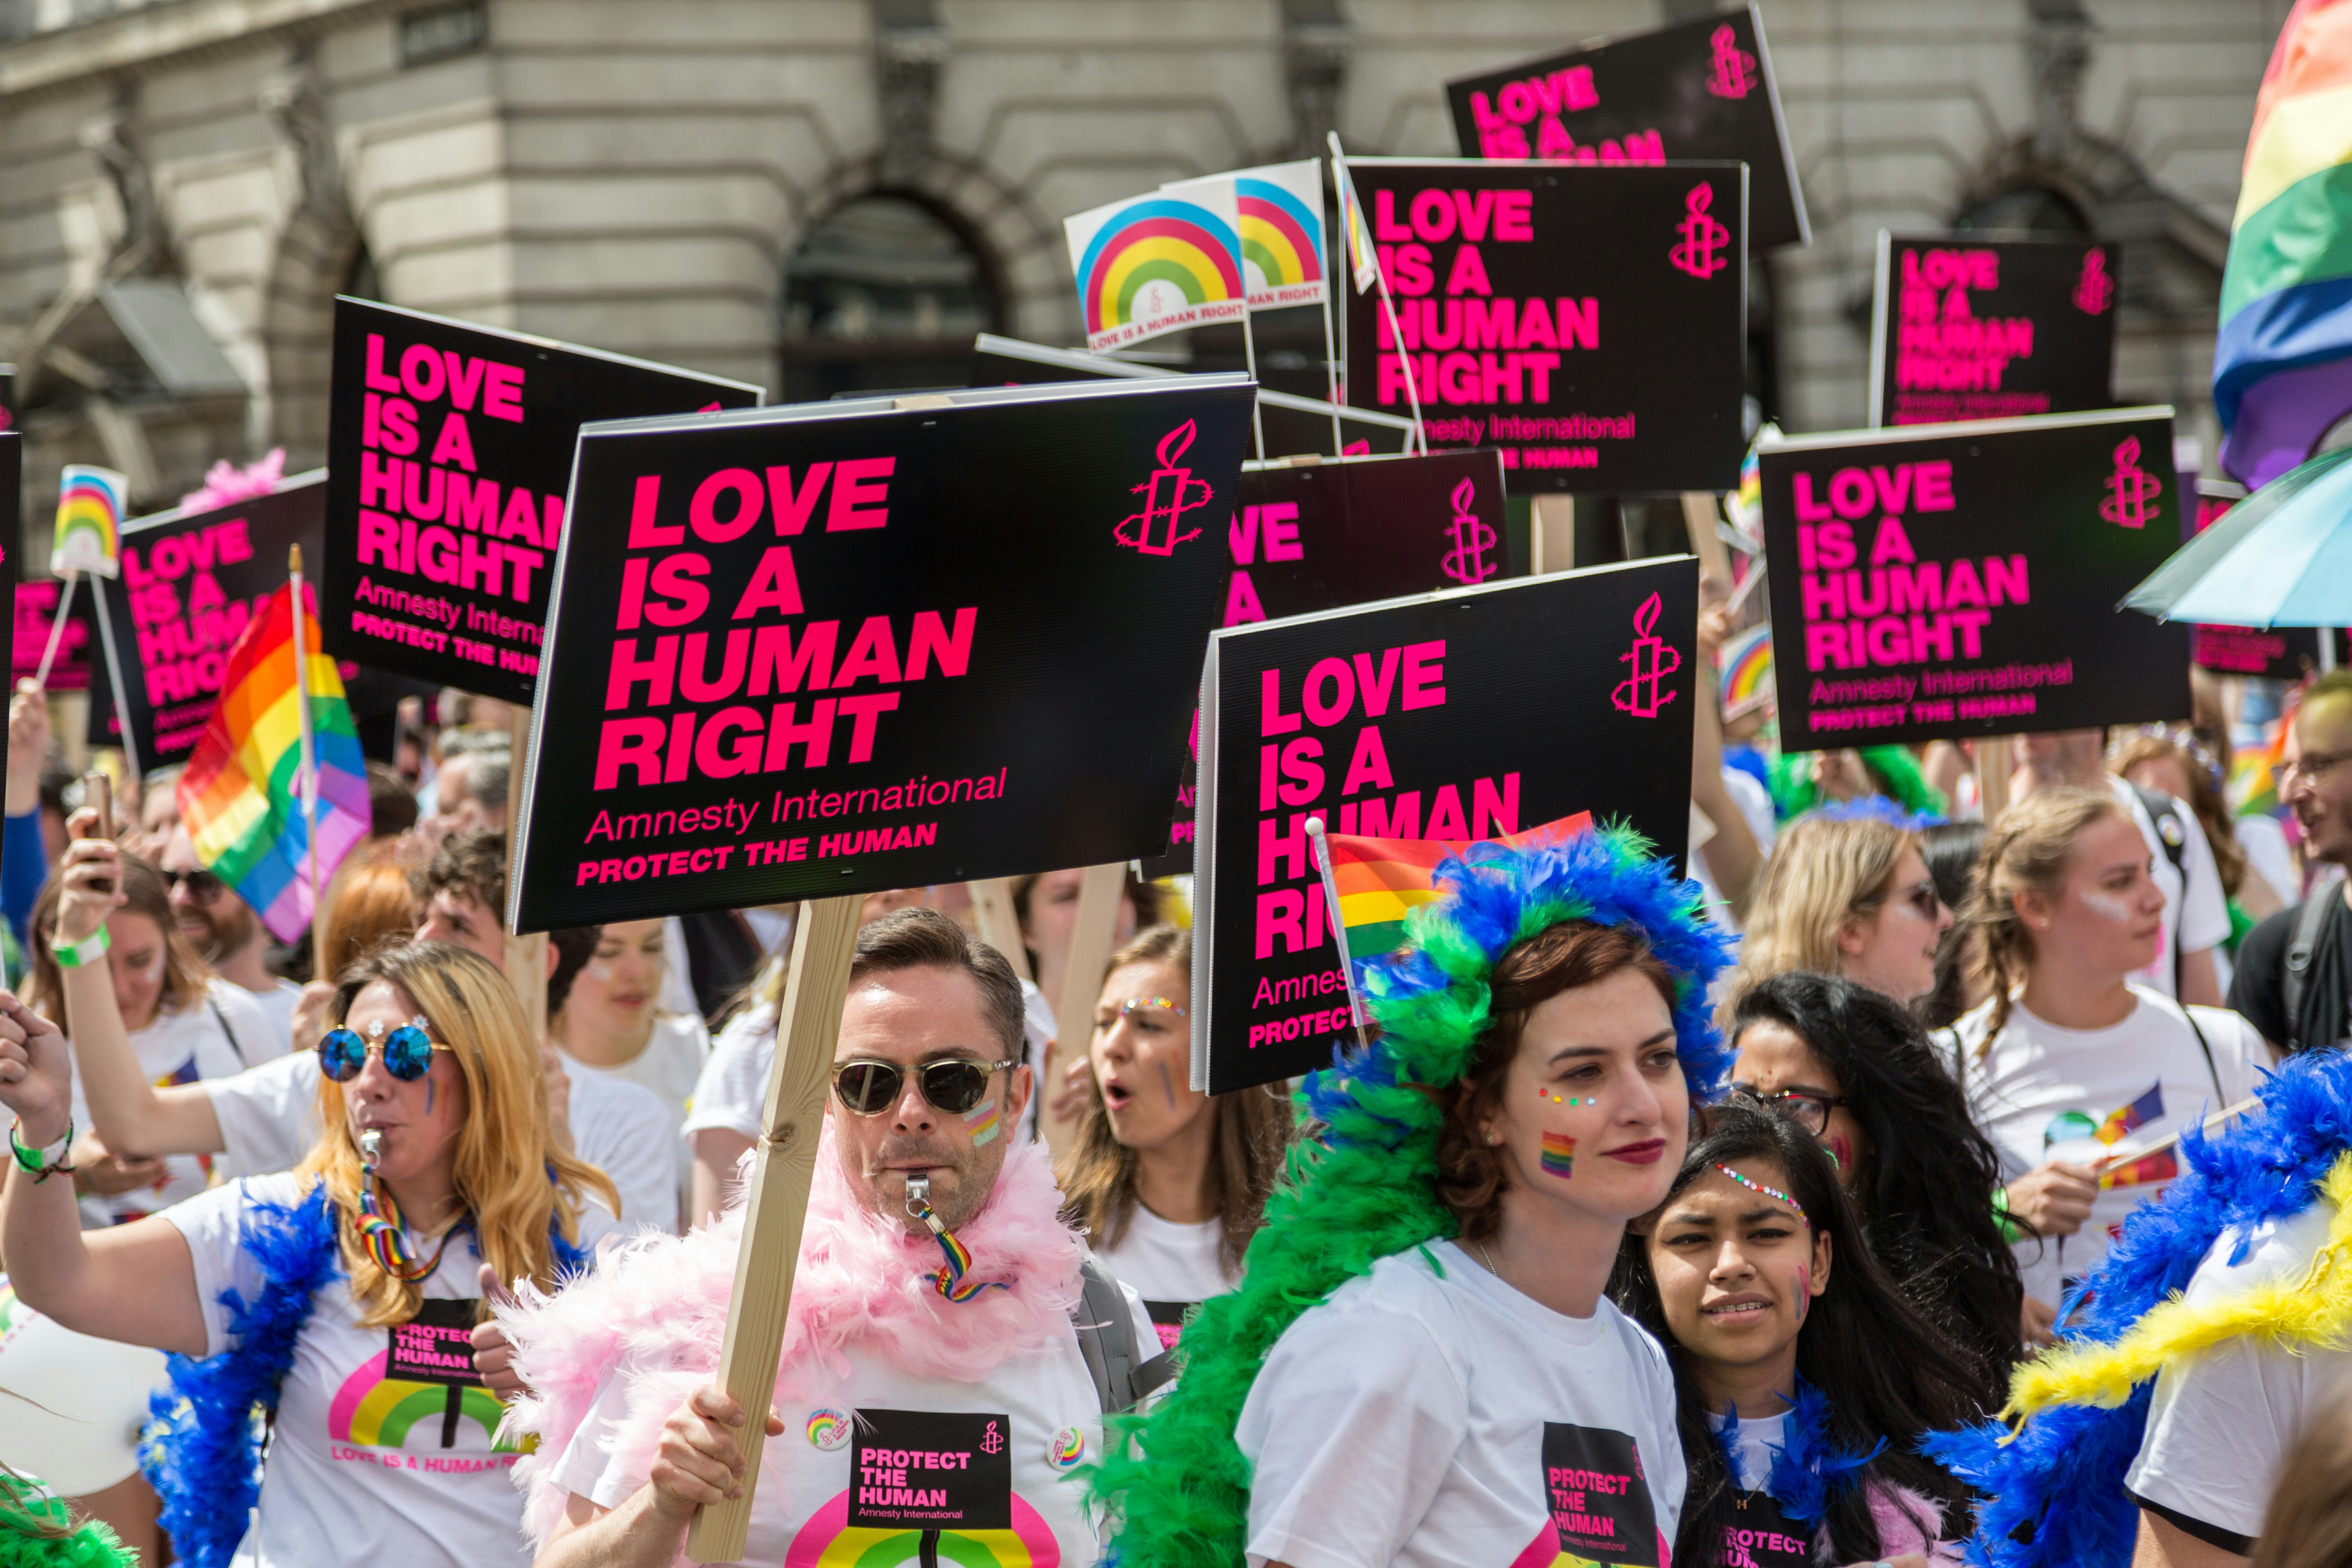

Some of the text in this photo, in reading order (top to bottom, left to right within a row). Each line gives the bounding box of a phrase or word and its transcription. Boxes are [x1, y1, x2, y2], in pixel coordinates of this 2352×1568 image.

[1469, 63, 1600, 124] LOVE
[1376, 188, 1534, 243] LOVE
[1279, 286, 1321, 301] RIGHT
[1376, 243, 1492, 297] IS A
[1901, 248, 1999, 290] LOVE
[1091, 304, 1244, 351] LOVE IS A HUMAN RIGHT
[1377, 297, 1599, 350] HUMAN
[1899, 317, 2034, 359] HUMAN
[366, 333, 525, 423] LOVE
[1378, 351, 1561, 406] RIGHT
[1897, 355, 2010, 392] RIGHT
[362, 392, 477, 472] IS A
[1489, 411, 1636, 440] International
[1521, 446, 1599, 469] HUMAN
[627, 456, 896, 549] LOVE
[1791, 459, 1956, 524] LOVE
[121, 518, 254, 591] LOVE
[357, 508, 544, 603] RIGHT
[1229, 501, 1304, 565] VE
[1795, 520, 1858, 573] IS
[1869, 515, 1917, 568] A
[128, 569, 227, 631] IS A
[354, 576, 461, 630] Amnesty
[616, 546, 803, 631] IS A
[1223, 570, 1268, 628] A
[1799, 553, 2031, 623] HUMAN
[351, 610, 449, 653] PROTECT
[452, 635, 496, 666] THE
[604, 607, 978, 712] HUMAN
[1805, 608, 1992, 673] RIGHT
[145, 649, 228, 708] RIG
[1261, 640, 1446, 737] LOVE
[1808, 675, 1918, 708] Amnesty
[1921, 656, 2074, 698] International
[1809, 691, 2036, 735] PROTECT THE HUMAN
[593, 691, 900, 791] RIGHT
[1259, 725, 1394, 812] IS A
[584, 767, 1007, 844] Amnesty International
[576, 823, 938, 887] PROTECT THE HUMAN
[1252, 967, 1348, 1009] Amnes
[394, 1348, 469, 1369] HUMAN
[395, 1323, 472, 1344] PROTEC
[395, 1335, 435, 1352] THE
[394, 1363, 481, 1379] Amnesty Internationa
[331, 1446, 377, 1463] LOVE
[383, 1454, 402, 1469] IS
[406, 1456, 418, 1471] A
[425, 1458, 498, 1474] HUMAN
[860, 1467, 907, 1487] THE
[861, 1447, 971, 1470] PROTECT
[1549, 1467, 1631, 1496] PROTECT
[858, 1508, 963, 1520] Amnesty International
[859, 1486, 946, 1507] HUMAN
[1551, 1489, 1586, 1512] THE
[1553, 1509, 1614, 1537] HUMAN
[1561, 1533, 1627, 1552] Amnesty International
